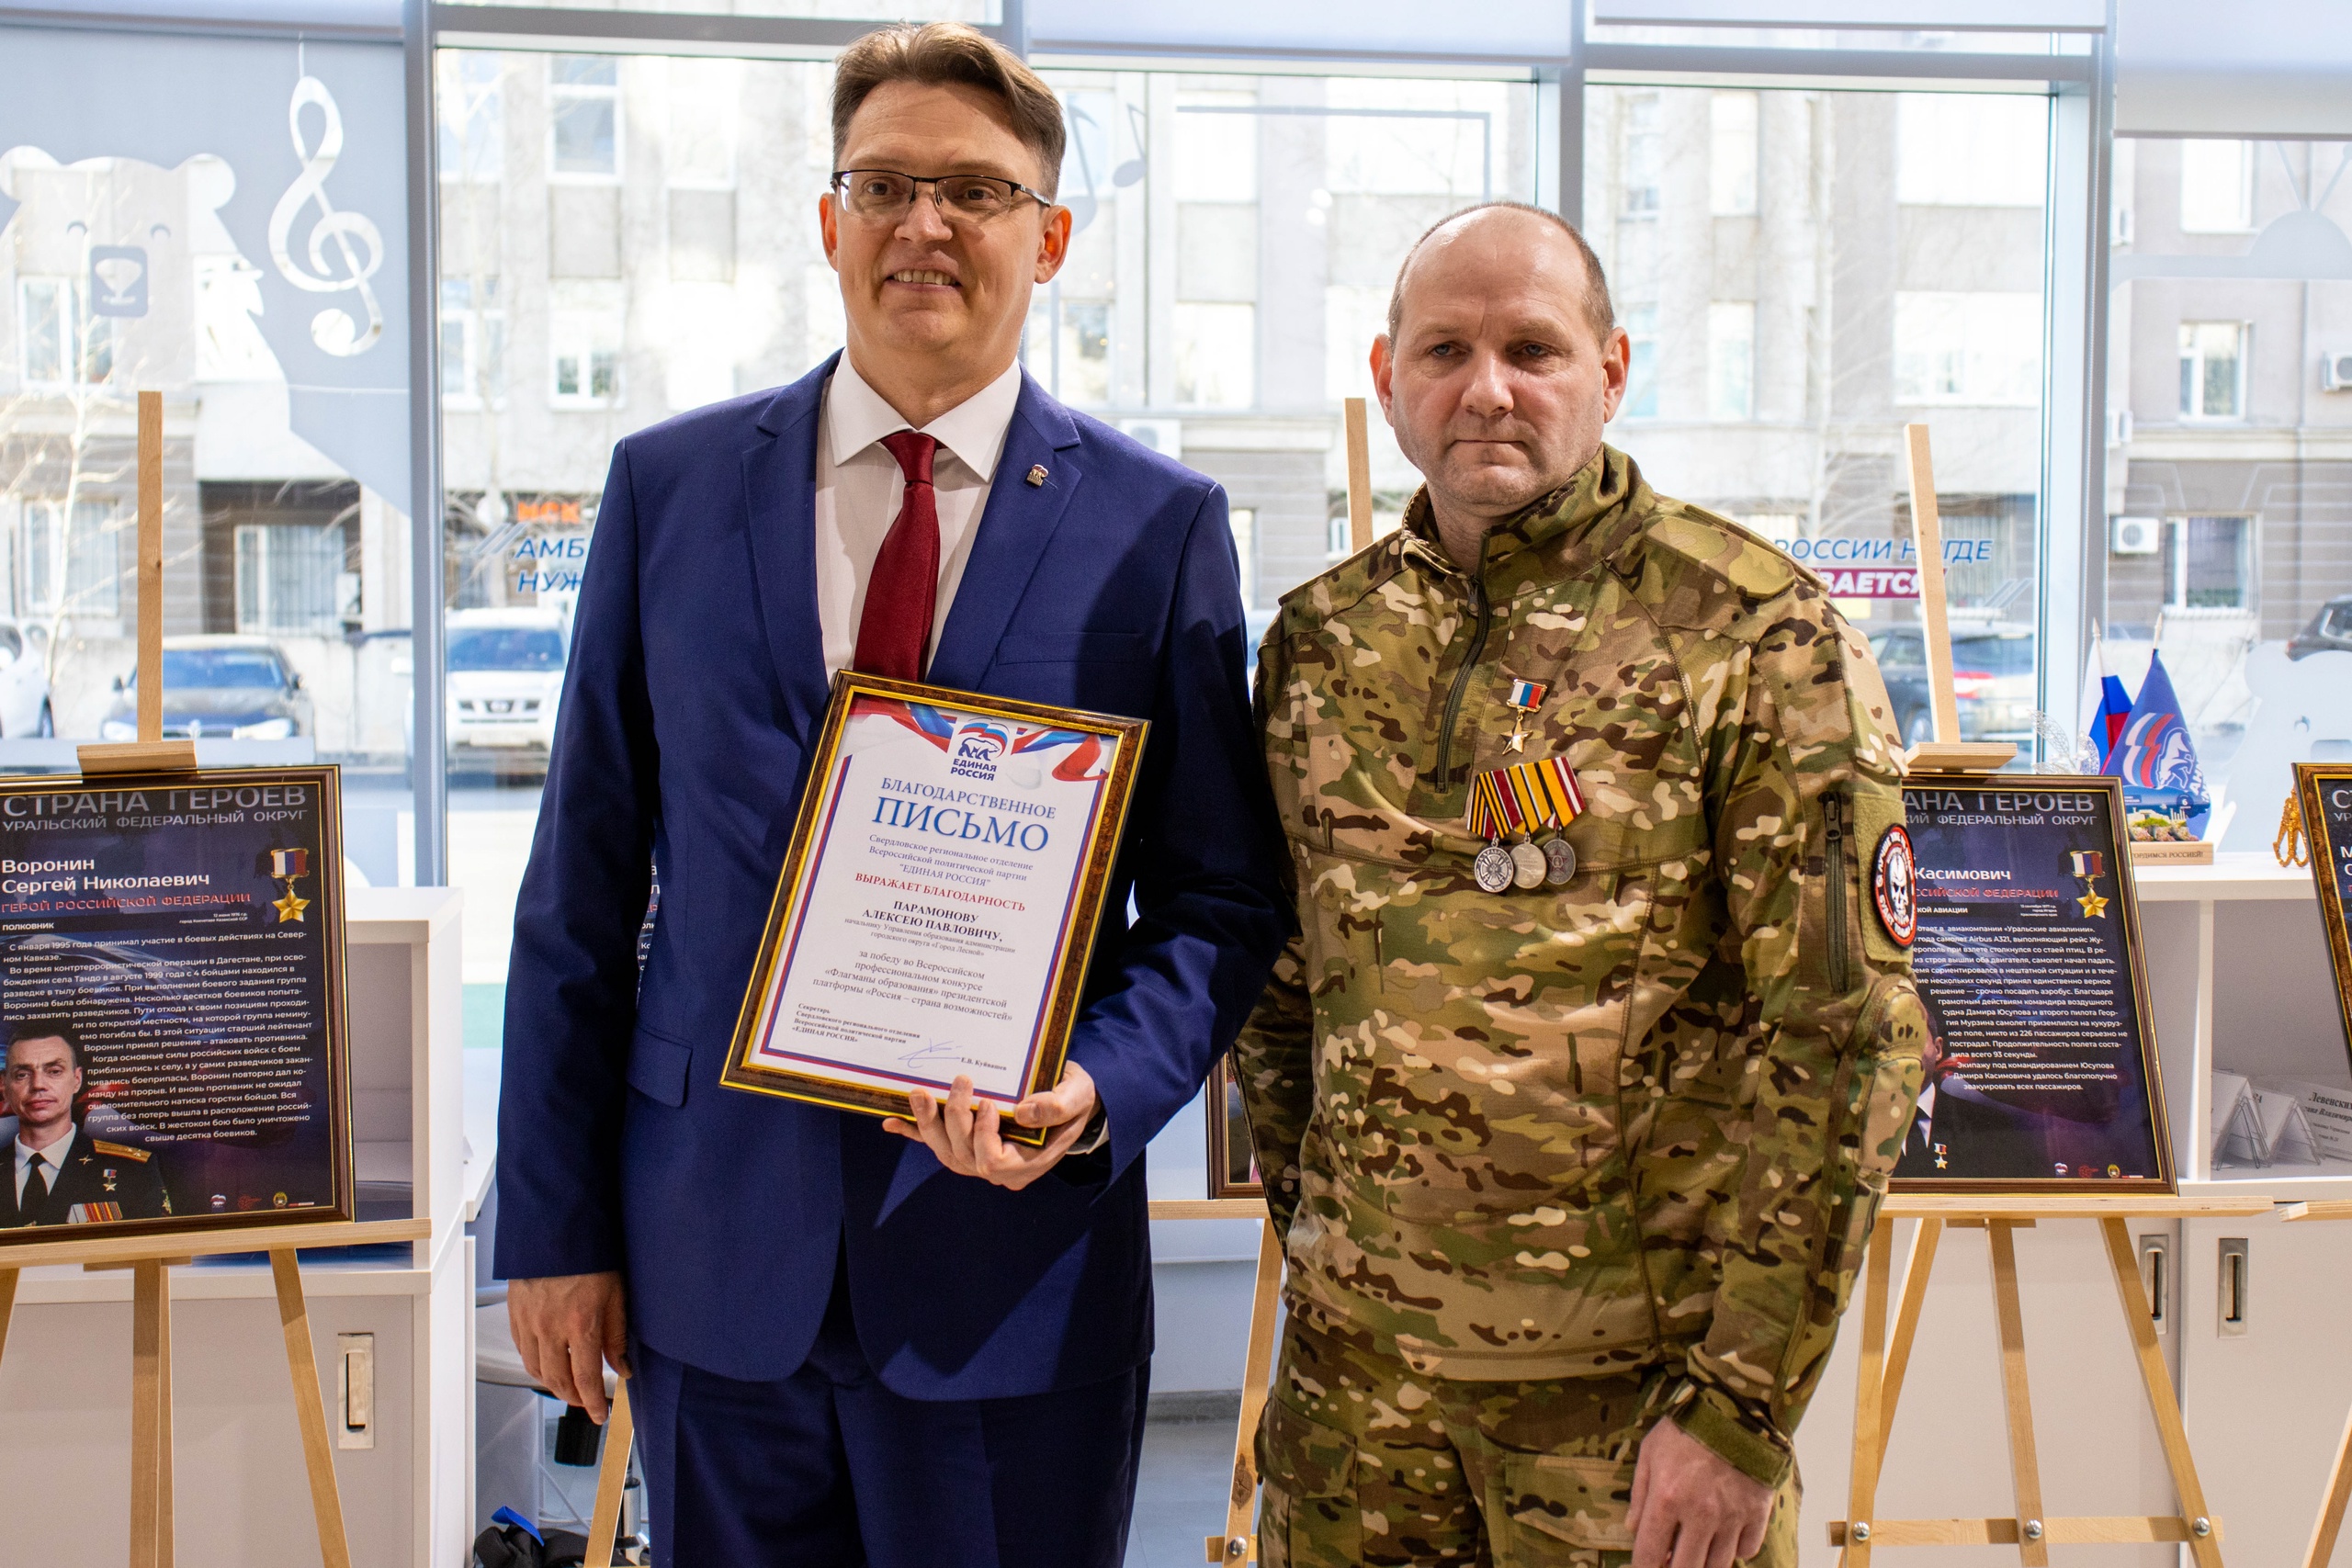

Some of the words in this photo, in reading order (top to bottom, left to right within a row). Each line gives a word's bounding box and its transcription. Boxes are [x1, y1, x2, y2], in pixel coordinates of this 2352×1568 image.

[1901, 539, 1993, 564] НГДЕ
[950, 766, 994, 781] РОССИЯ
[953, 758, 997, 772] ЕДИНАЯ
[4, 791, 150, 817] СТРАНА
[168, 785, 306, 810] ГЕРОЕВ
[881, 777, 1056, 818] БЛАГОДАРСТВЕННОЕ
[1978, 792, 2094, 811] ГЕРОЕВ
[2, 815, 106, 831] УРАЛЬСКИЙ
[116, 809, 243, 828] ФЕДЕРАЛЬНЫЙ
[253, 809, 307, 821] ОКРУГ
[872, 796, 1049, 852] ПИСЬМО
[1937, 812, 2044, 826] ФЕДЕРАЛЬНЫЙ
[2051, 815, 2097, 825] ОКРУГ
[869, 834, 928, 851] Свердловское
[928, 846, 988, 862] региональное
[989, 858, 1033, 870] отделение
[1, 859, 95, 874] Воронин
[868, 845, 932, 863] Всероссийской
[933, 859, 994, 874] политической
[996, 870, 1026, 881] партии
[1915, 866, 2011, 880] Касимович
[1, 875, 76, 895] Сергей
[84, 874, 209, 889] Николаевич
[854, 873, 922, 891] ВЫРАЖАЕТ
[922, 885, 1024, 910] БЛАГОДАРНОСТЬ
[1983, 888, 2059, 898] ФЕДЕРАЦИИ
[0, 899, 51, 913] ГЕРОЙ
[54, 895, 156, 910] РОССИЙСКОЙ
[161, 892, 250, 906] ФЕДЕРАЦИИ
[894, 900, 979, 923] ПАРАМОНОВУ
[2, 922, 54, 931] полковник
[862, 908, 922, 926] АЛЕКСЕЮ
[925, 919, 1001, 942] ПАВЛОВИЧУ,
[844, 918, 880, 930] начальнику
[883, 923, 922, 936] Управления
[922, 931, 964, 943] образования
[964, 940, 1015, 953] администрации
[23, 965, 51, 975] время
[53, 959, 162, 972] контртеррористической
[164, 958, 208, 967] операции
[215, 955, 263, 964] Дагестане,
[869, 953, 900, 965] победу
[916, 959, 984, 979] Всероссийском
[854, 962, 939, 983] профессиональном
[941, 978, 982, 990] конкурсе
[824, 968, 876, 983] «Флагманы
[877, 977, 938, 994] образования»
[940, 990, 1006, 1008] президентской
[2040, 987, 2073, 996] аэробус.
[2073, 987, 2114, 996] Благодаря
[797, 1002, 830, 1014] Секретарь
[812, 978, 864, 993] платформы
[865, 987, 901, 1000] «Россия
[911, 998, 941, 1008] страна
[943, 1002, 1012, 1020] возможностей»
[1941, 1009, 1964, 1017] судна
[1965, 1008, 1996, 1016] Дамира
[1996, 1008, 2031, 1017] Юсупова
[2098, 1009, 2118, 1017] Геор-
[794, 1017, 839, 1031] Всероссийской
[840, 1027, 882, 1039] политической
[883, 1035, 906, 1043] партии
[796, 1010, 842, 1023] Свердловского
[842, 1020, 888, 1032] регионального
[888, 1029, 920, 1038] отделения
[84, 1043, 124, 1052] Воронин
[125, 1041, 159, 1050] принял
[161, 1039, 201, 1048] решение
[209, 1036, 253, 1044] атаковать
[254, 1033, 308, 1043] противника.
[119, 1053, 164, 1061] основные
[189, 1048, 242, 1058] российских
[243, 1046, 269, 1055] войск
[277, 1044, 300, 1053] боем
[1992, 1040, 2070, 1048] Продолжительность
[1956, 1061, 1991, 1069] Экипажу
[2079, 1061, 2114, 1070] Юсупова
[130, 1075, 189, 1084] боеприпасы,
[190, 1073, 230, 1081] Воронин
[232, 1070, 274, 1078] повторно
[2064, 1072, 2118, 1080] благополучно
[129, 1122, 157, 1131] войск.
[166, 1120, 210, 1128] жестоком
[211, 1118, 231, 1126] бою
[256, 1114, 310, 1125] уничтожено
[175, 1132, 211, 1141] десятка
[212, 1129, 257, 1137] боевиков.
